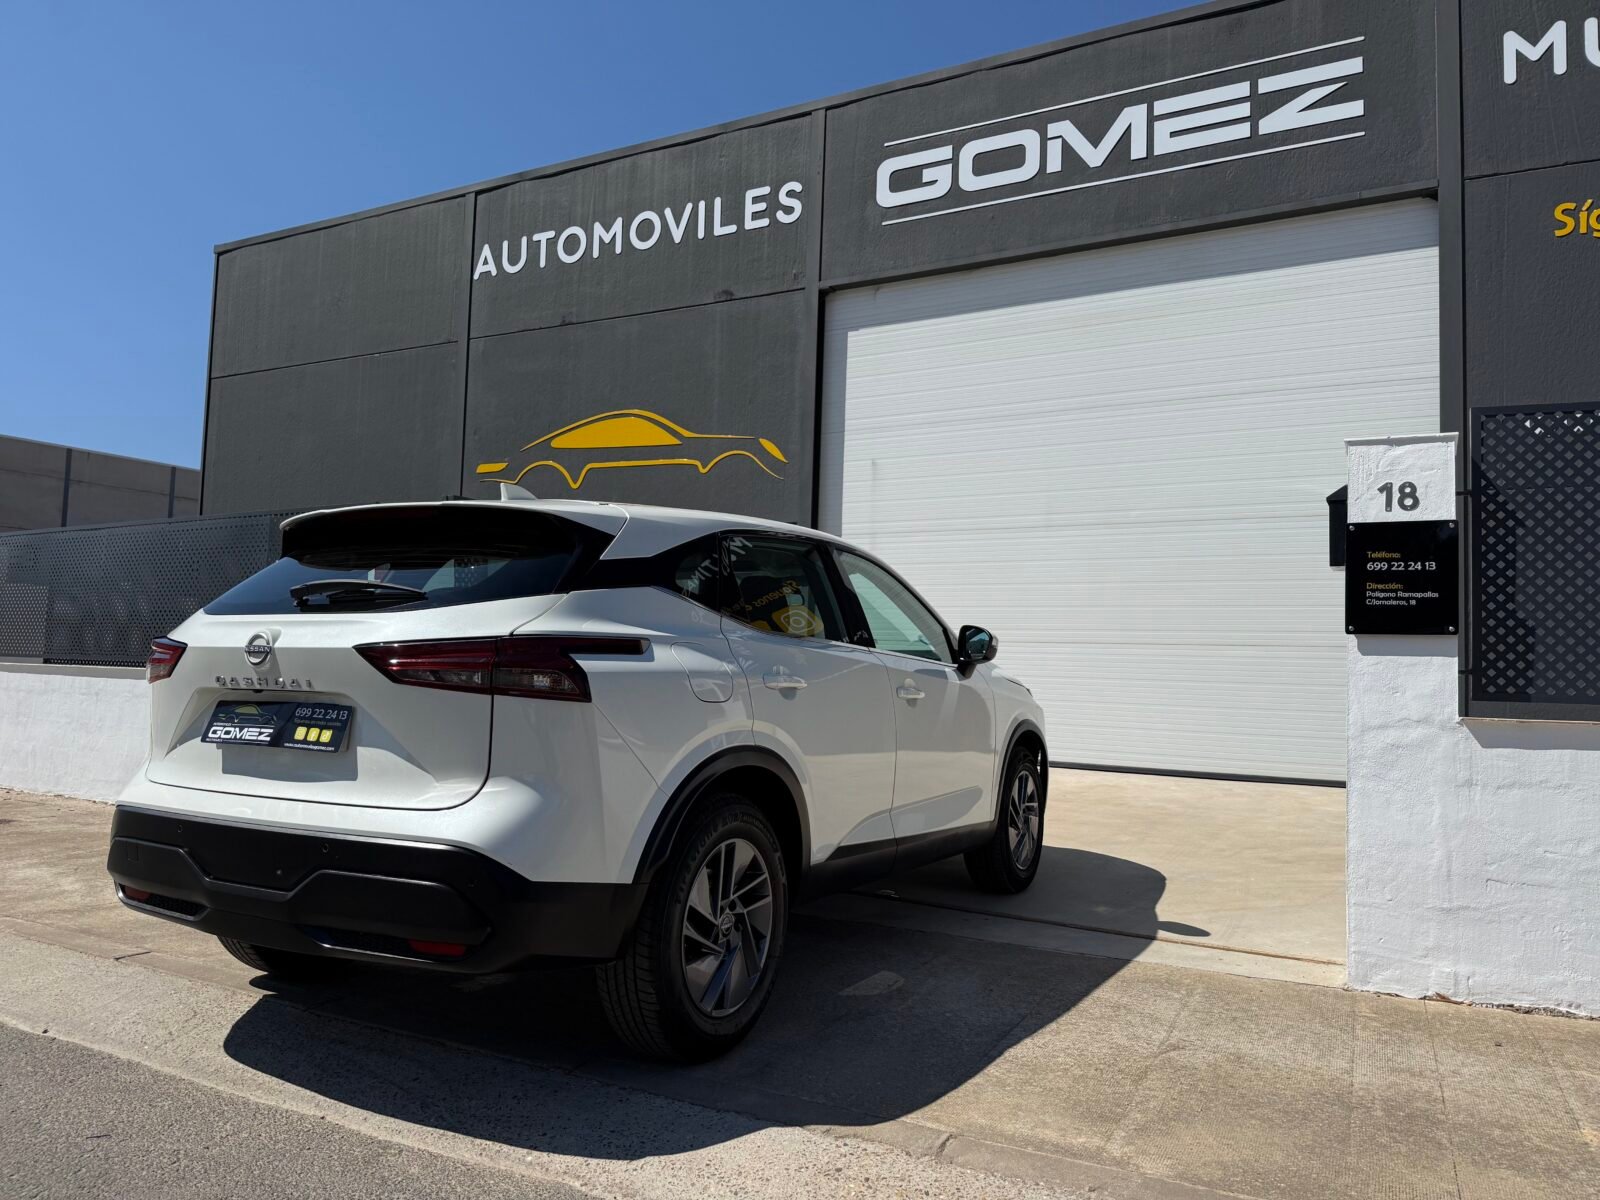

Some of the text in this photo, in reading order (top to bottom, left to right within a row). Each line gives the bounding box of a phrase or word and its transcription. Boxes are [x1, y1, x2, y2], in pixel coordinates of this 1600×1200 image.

[876, 56, 1364, 208] GOMEZ
[473, 181, 803, 280] AUTOMOVILES
[1377, 481, 1420, 512] 18
[1367, 562, 1437, 571] 699 22 24 13
[1397, 591, 1439, 599] Ramapallas
[295, 707, 349, 720] 699 22 24 13
[208, 726, 274, 741] GOMEZ
